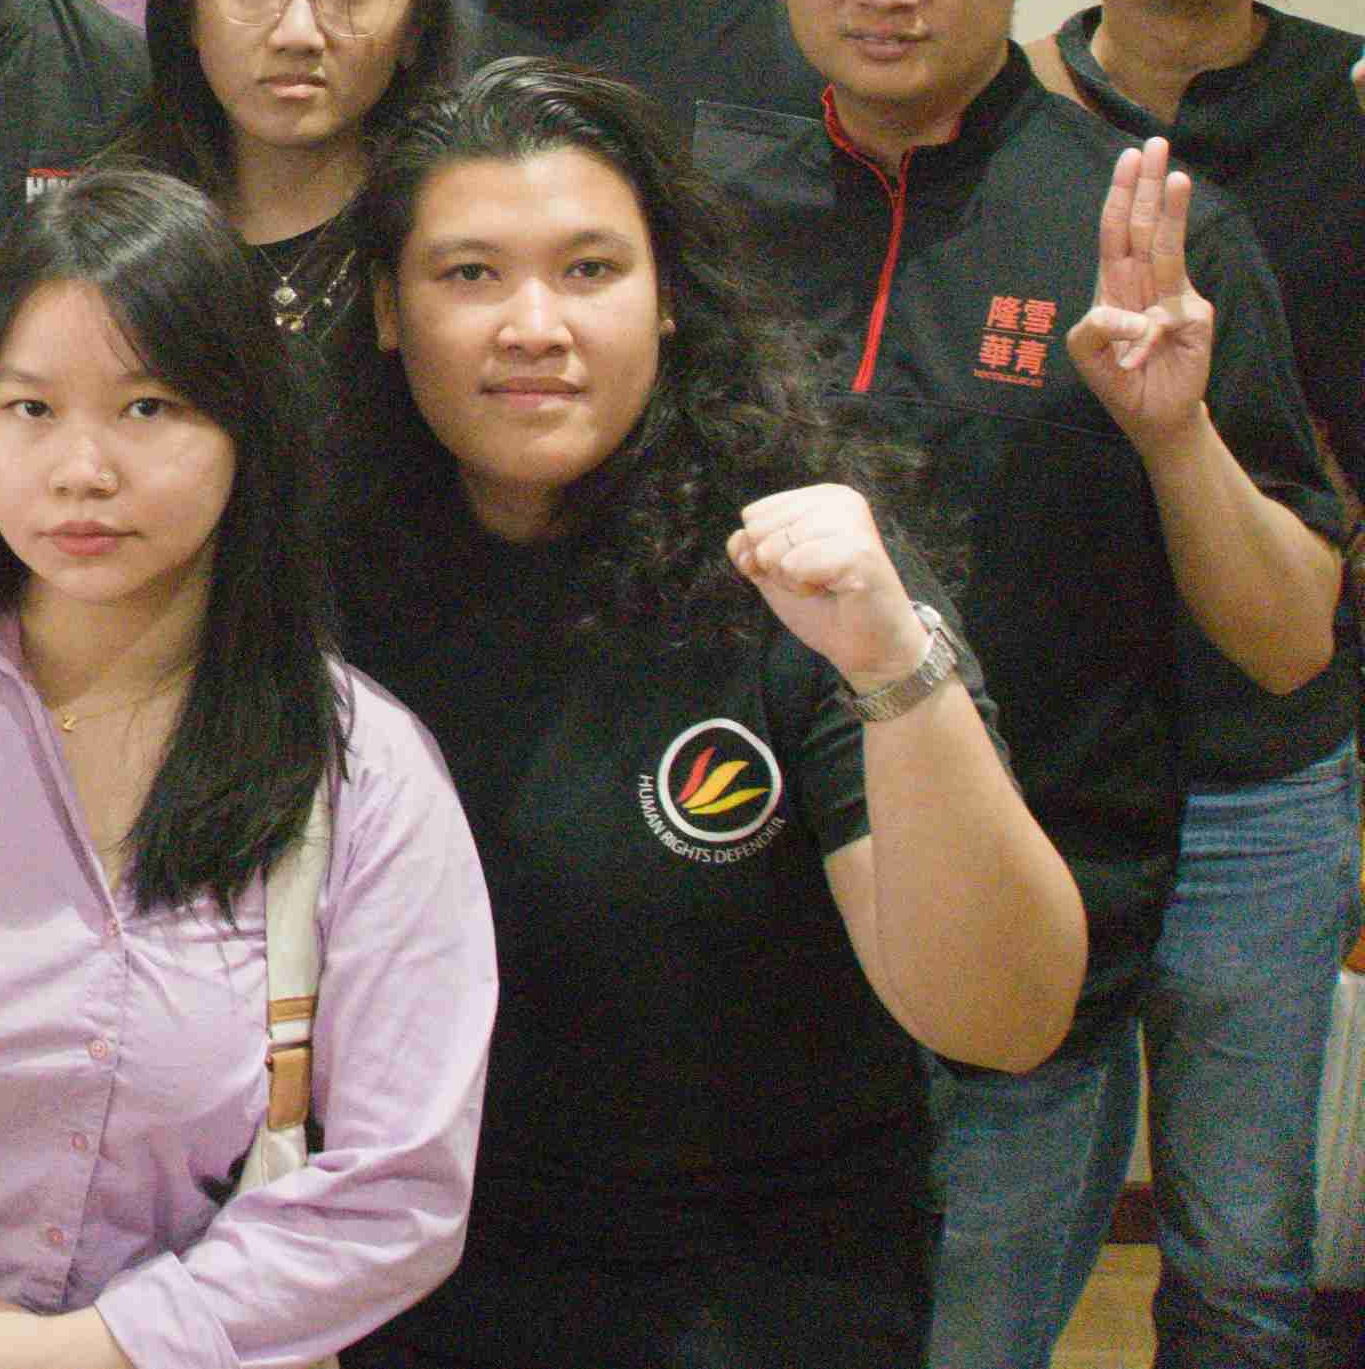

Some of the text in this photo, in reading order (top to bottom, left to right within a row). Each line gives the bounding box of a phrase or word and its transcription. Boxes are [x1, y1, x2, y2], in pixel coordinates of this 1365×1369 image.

[638, 774, 787, 864] HUMAN RIGHTS DEFENDER
